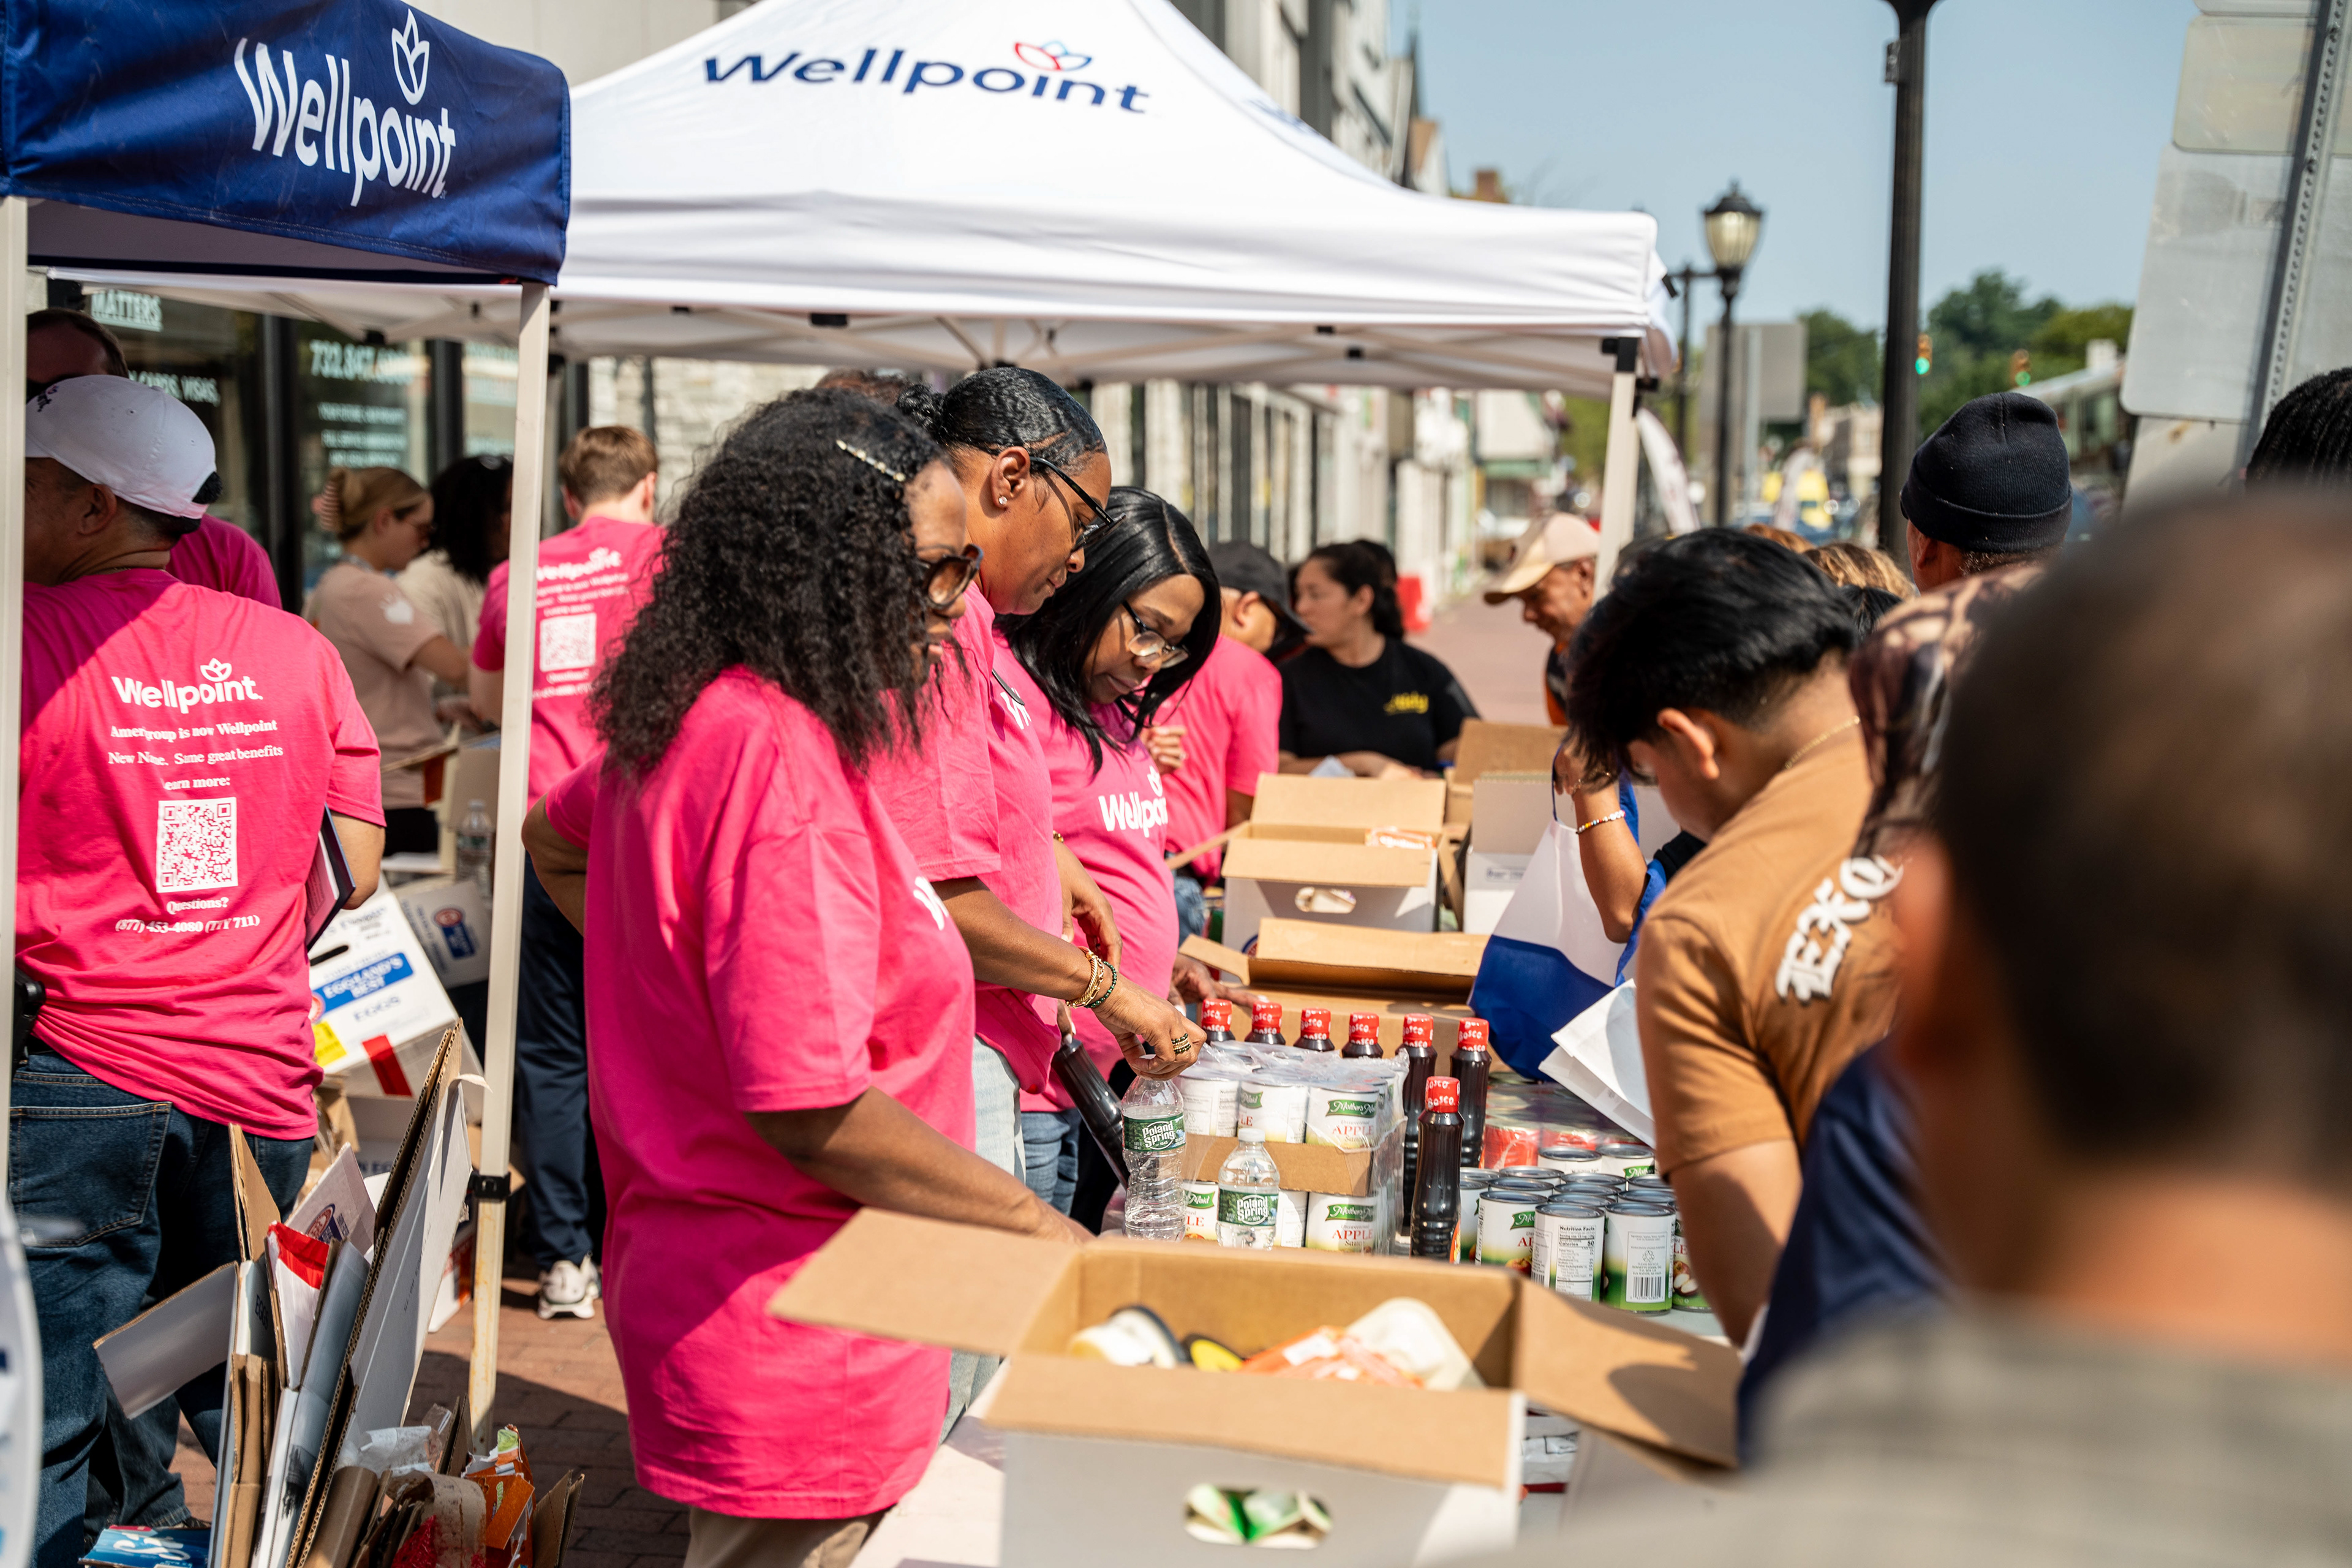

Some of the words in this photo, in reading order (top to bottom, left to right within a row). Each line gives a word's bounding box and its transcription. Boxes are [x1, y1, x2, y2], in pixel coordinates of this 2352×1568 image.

[704, 48, 1150, 113] Wellpoint
[235, 37, 456, 207] Wellpoint
[111, 676, 260, 714] Wellpoint
[178, 728, 190, 739] is
[216, 720, 277, 736] Wellpoint
[108, 752, 135, 764] New
[207, 750, 236, 764] great
[236, 745, 284, 759] benefits
[162, 780, 190, 791] earn
[193, 777, 230, 788] more:
[167, 897, 229, 915] Questions?
[232, 915, 260, 928] 711)
[1142, 1120, 1174, 1139] Poland
[1332, 1125, 1374, 1136] APPLE
[1144, 1130, 1175, 1148] Spring
[1237, 1196, 1268, 1210] Poland
[1237, 1206, 1269, 1221] Spring
[1332, 1229, 1373, 1240] APPLE
